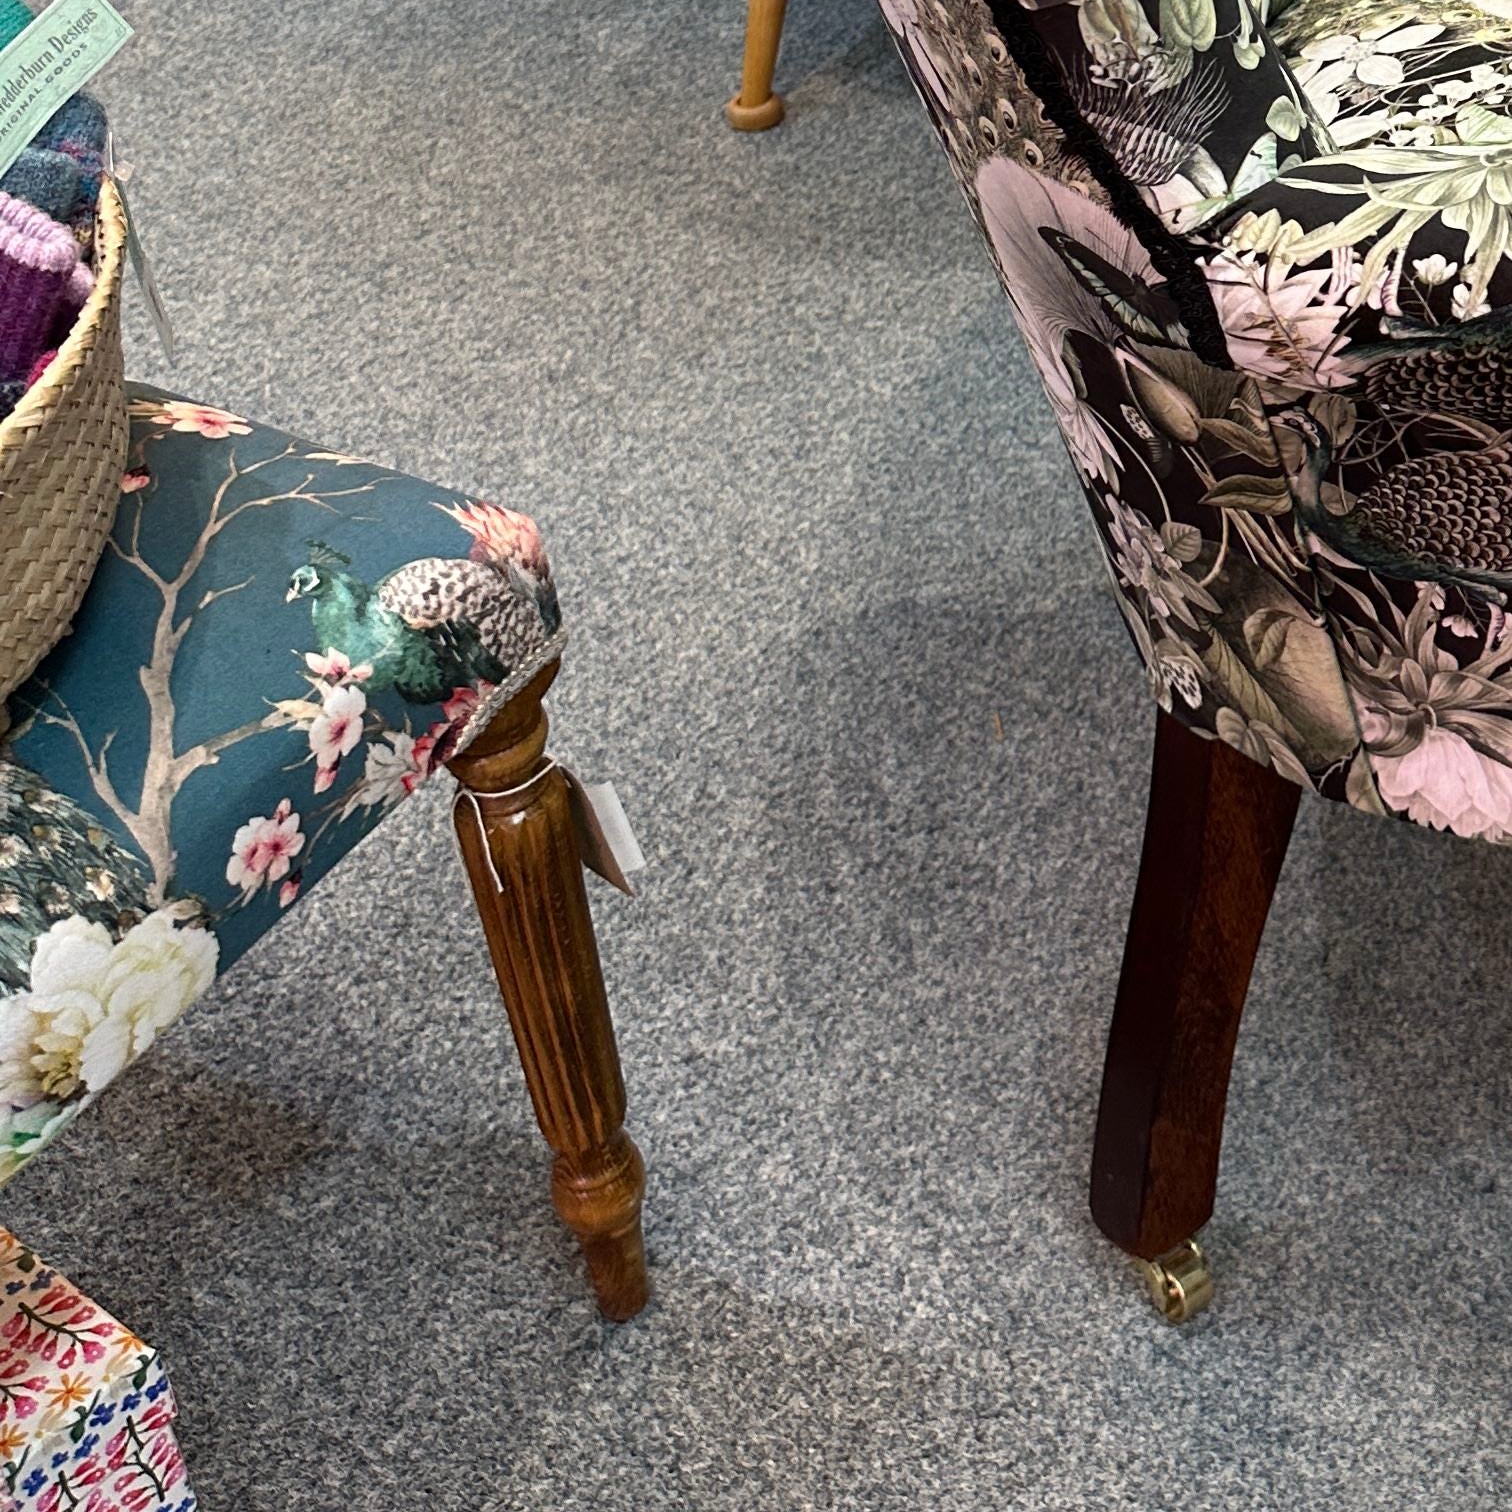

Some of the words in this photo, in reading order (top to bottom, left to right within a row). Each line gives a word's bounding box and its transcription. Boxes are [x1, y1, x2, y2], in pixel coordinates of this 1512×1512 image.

[48, 7, 98, 54] Designs
[0, 87, 41, 139] RIGINAL
[45, 41, 88, 85] GOODS
